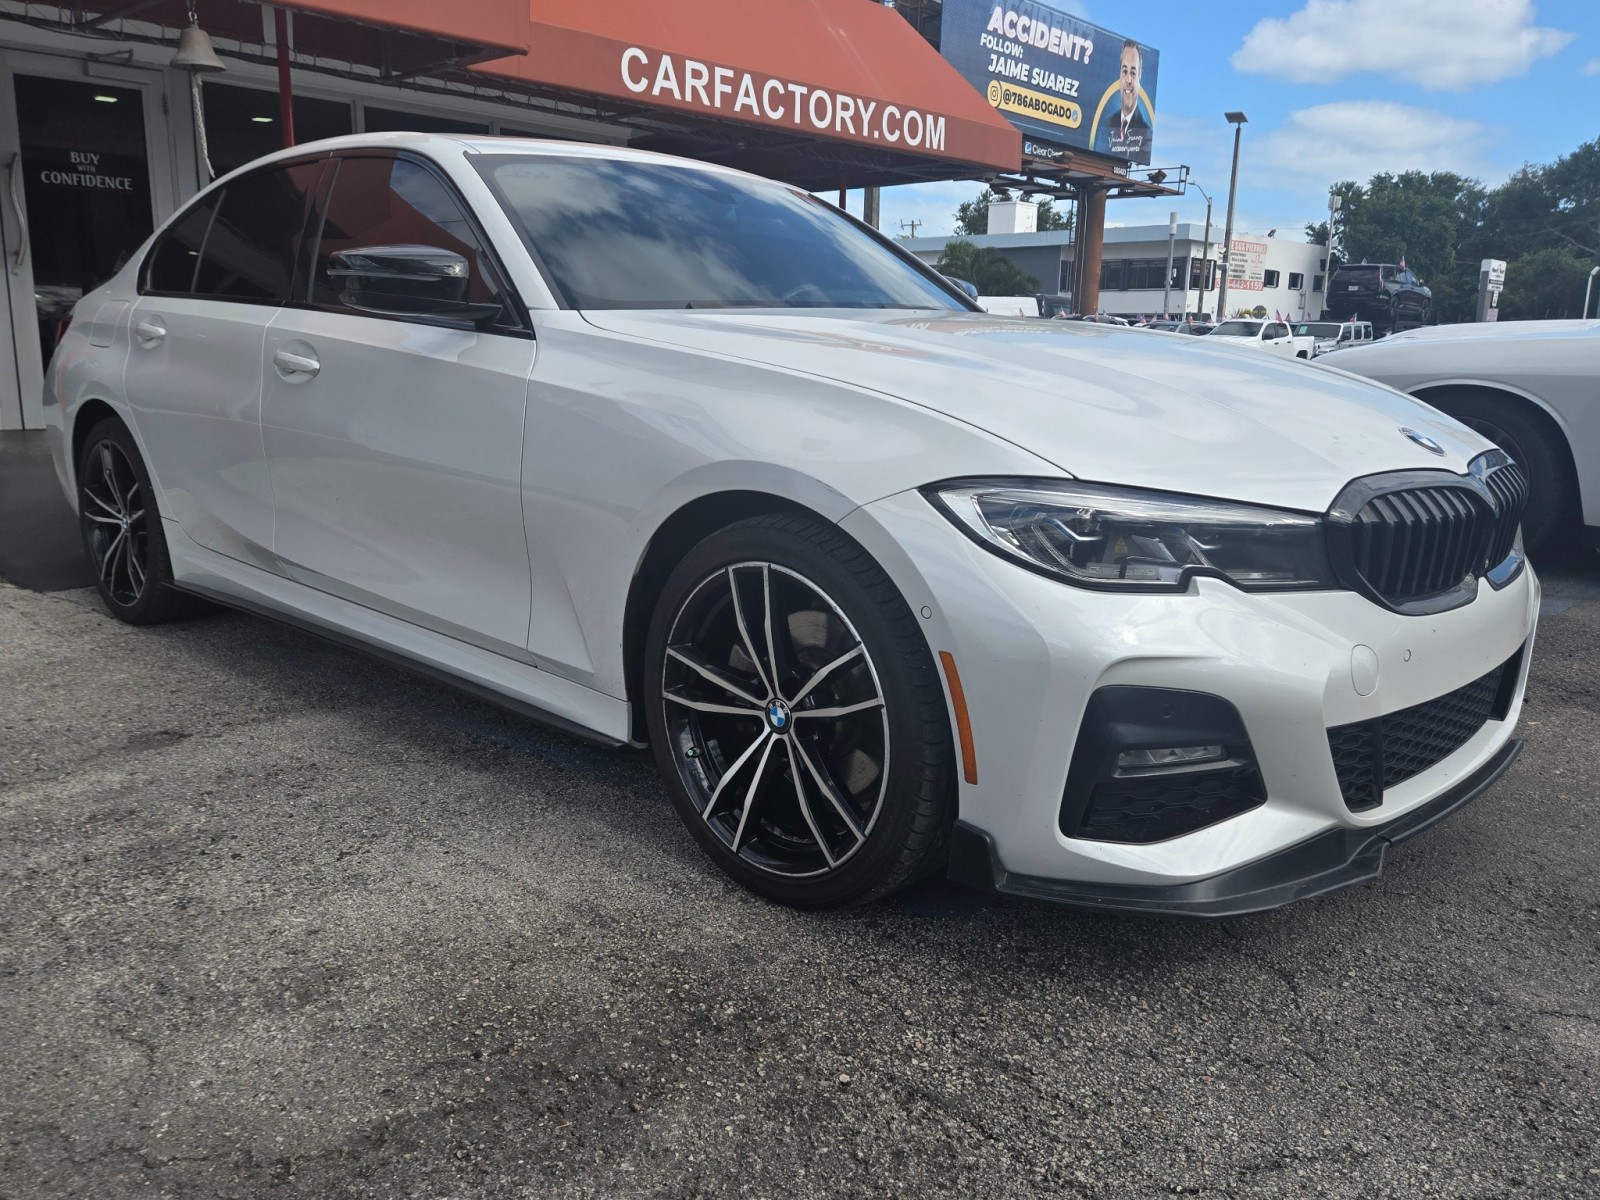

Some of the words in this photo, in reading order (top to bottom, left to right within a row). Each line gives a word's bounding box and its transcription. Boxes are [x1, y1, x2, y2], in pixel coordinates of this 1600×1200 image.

[980, 33, 1024, 58] FOLLOW:
[987, 6, 1094, 65] ACCIDENT?
[988, 54, 1030, 82] JAIME
[1031, 67, 1080, 97] SUAREZ
[620, 47, 946, 151] CARFACTORY.COM
[1003, 89, 1072, 119] @786ABOGADO
[70, 151, 100, 165] BUY
[1032, 144, 1048, 156] Clear
[41, 170, 133, 190] CONFIDENCE
[77, 164, 96, 172] WITH
